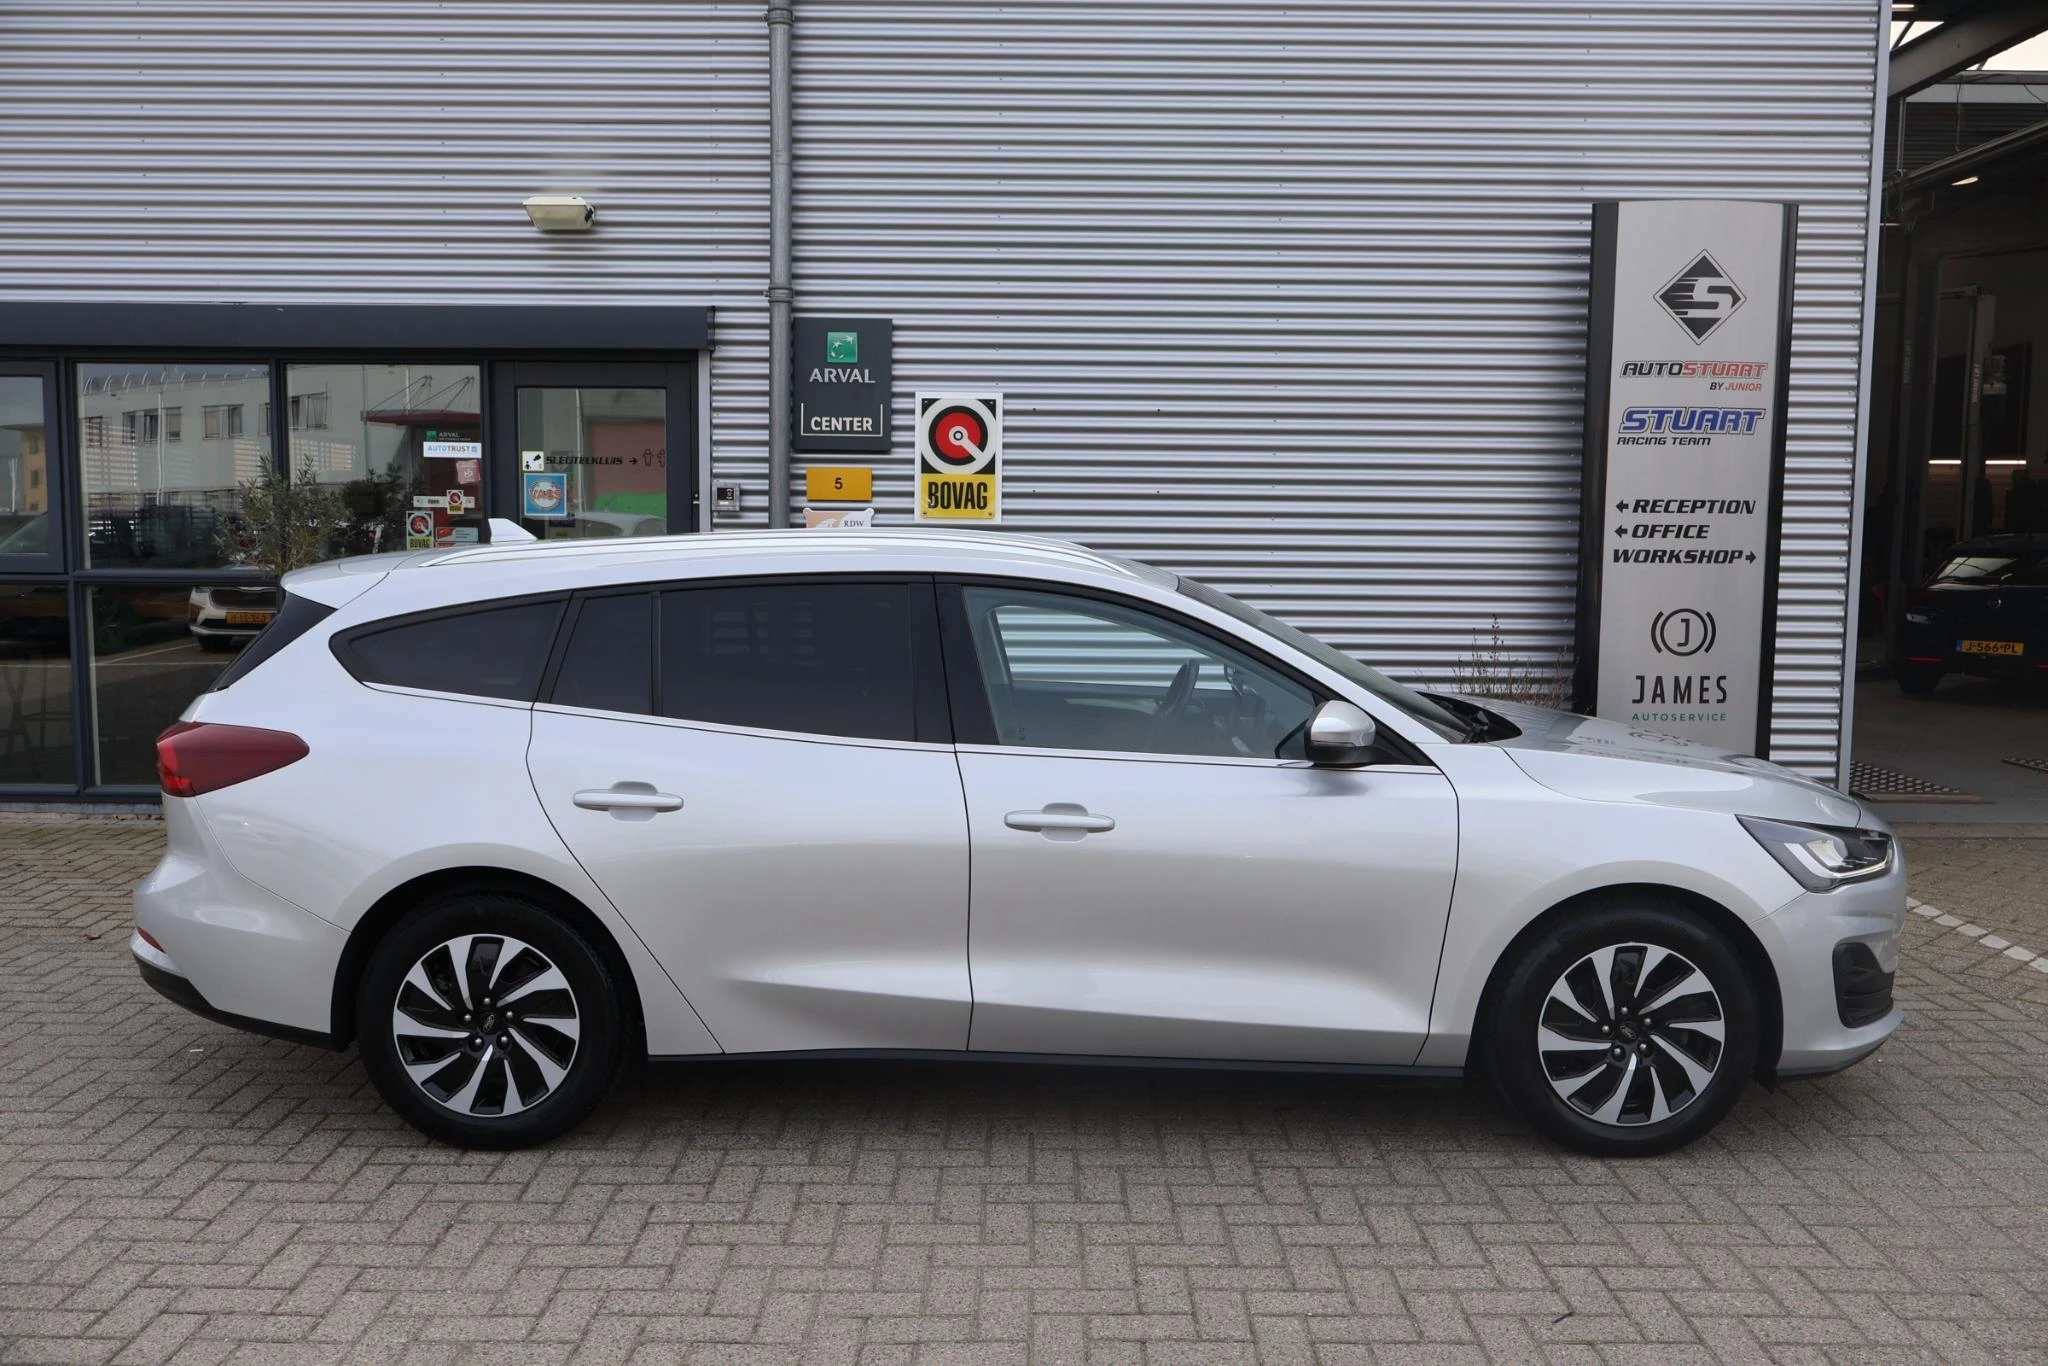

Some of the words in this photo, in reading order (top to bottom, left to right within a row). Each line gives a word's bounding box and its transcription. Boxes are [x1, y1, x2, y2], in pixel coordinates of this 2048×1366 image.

[809, 367, 876, 384] ARVAL
[1620, 360, 1768, 379] AUTOSTUART
[1709, 382, 1724, 391] BY
[1725, 382, 1762, 391] JUNIOR
[810, 416, 873, 431] CENTER
[1618, 407, 1766, 435] STUART
[1616, 436, 1667, 445] RACING
[1671, 437, 1711, 446] TEAM
[427, 445, 470, 453] AUTOTRUST
[834, 477, 843, 490] 5
[927, 481, 988, 510] BOVAG
[1632, 499, 1756, 514] RECEPTION
[843, 519, 865, 528] RDW
[1631, 524, 1710, 539] OFFICE
[1612, 549, 1743, 564] WORKSHOP
[1965, 641, 2019, 654] J-566-PL
[1632, 675, 1727, 704] JAMES
[1632, 712, 1727, 722] AUTOSERVICE
